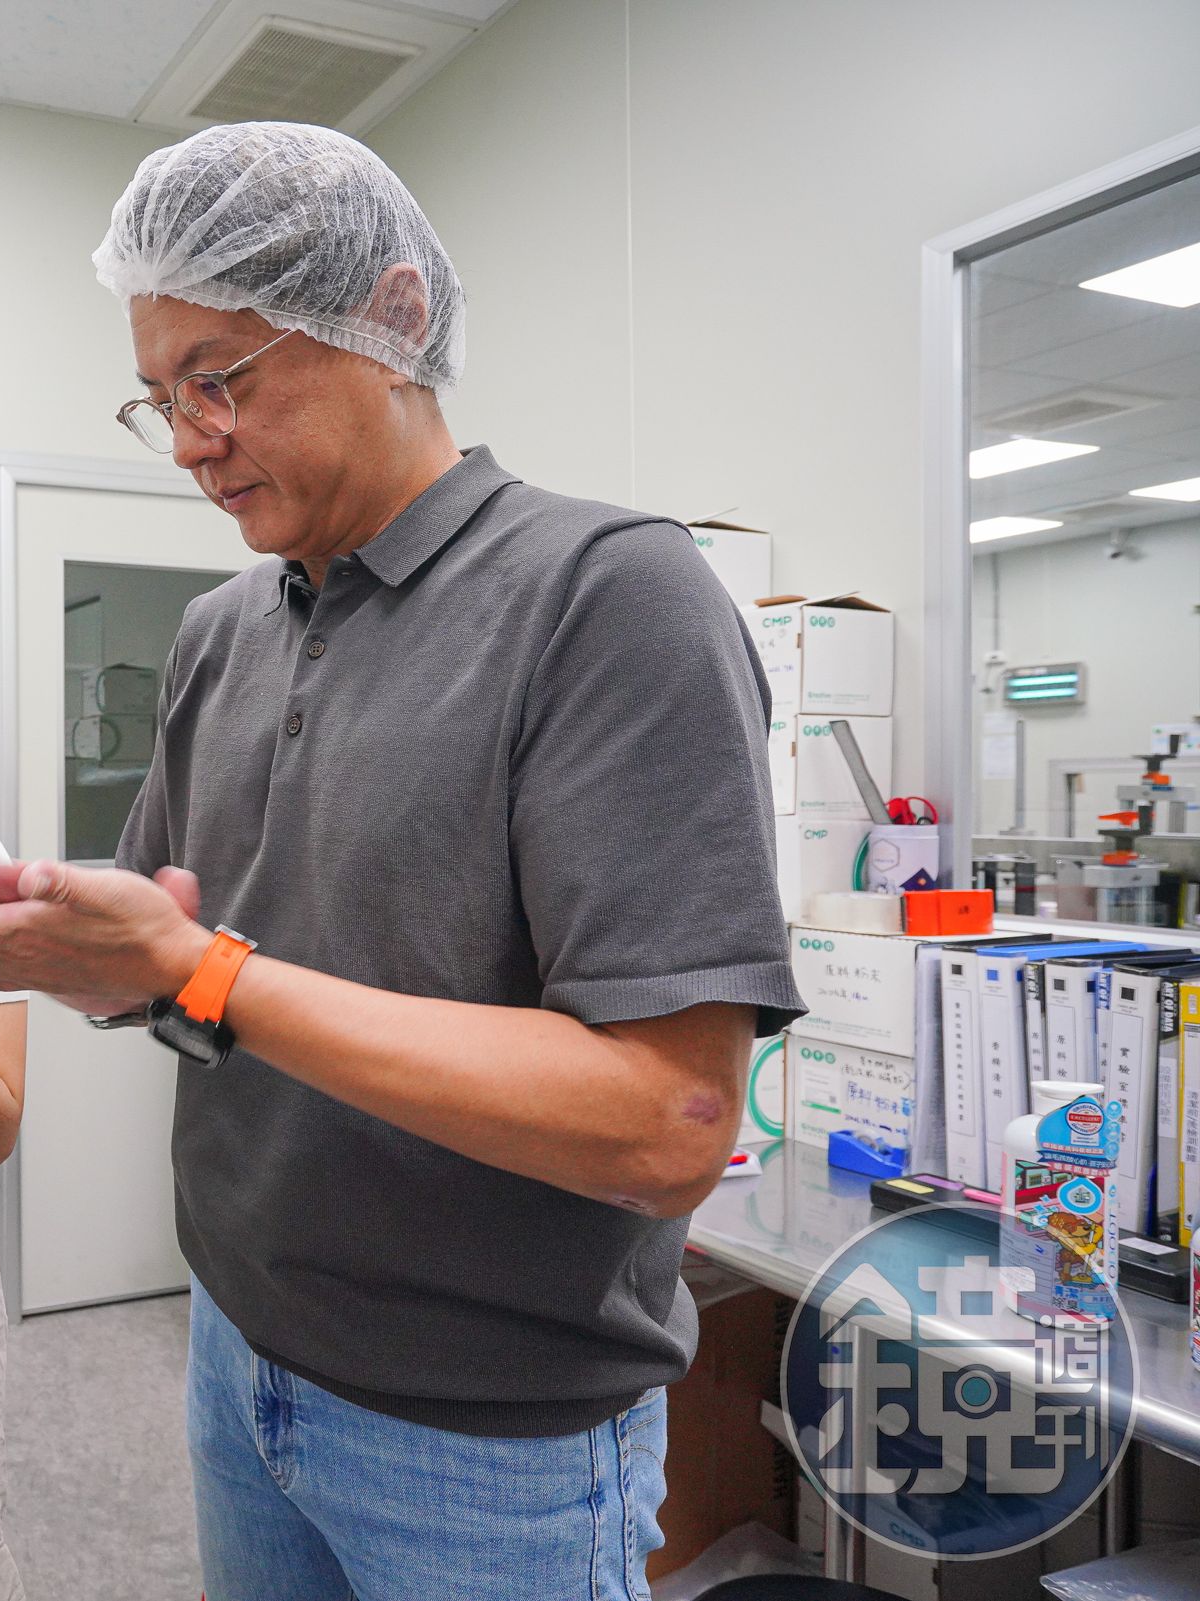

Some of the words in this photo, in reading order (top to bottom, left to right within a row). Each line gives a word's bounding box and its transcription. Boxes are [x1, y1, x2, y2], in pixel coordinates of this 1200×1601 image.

[762, 616, 792, 628] CMP
[771, 721, 787, 731] MP
[804, 829, 828, 840] CMP
